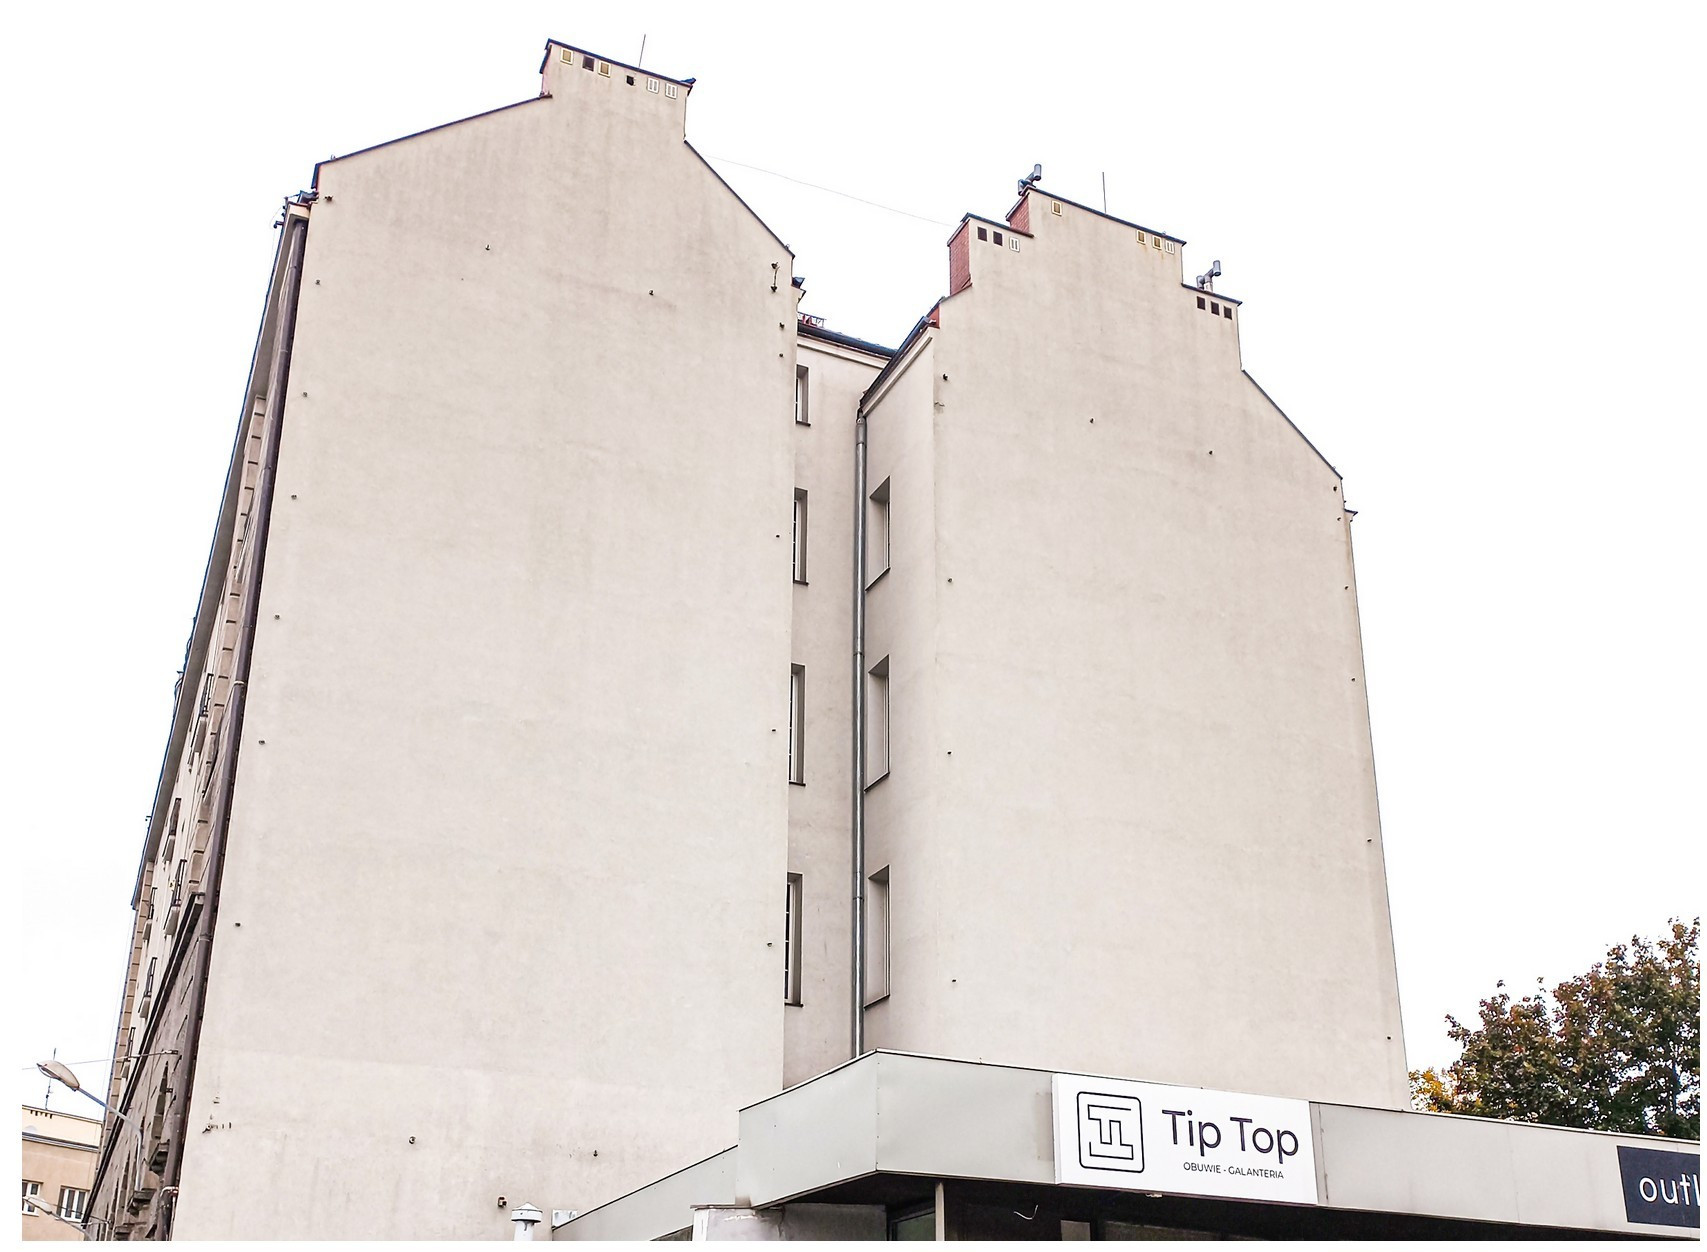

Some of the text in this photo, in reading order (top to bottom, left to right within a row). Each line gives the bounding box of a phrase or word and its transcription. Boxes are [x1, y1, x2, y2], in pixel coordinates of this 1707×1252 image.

[1162, 1109, 1299, 1164] Tip Top
[1183, 1161, 1222, 1174] OBUWIE
[1228, 1166, 1284, 1179] GALANTERIA
